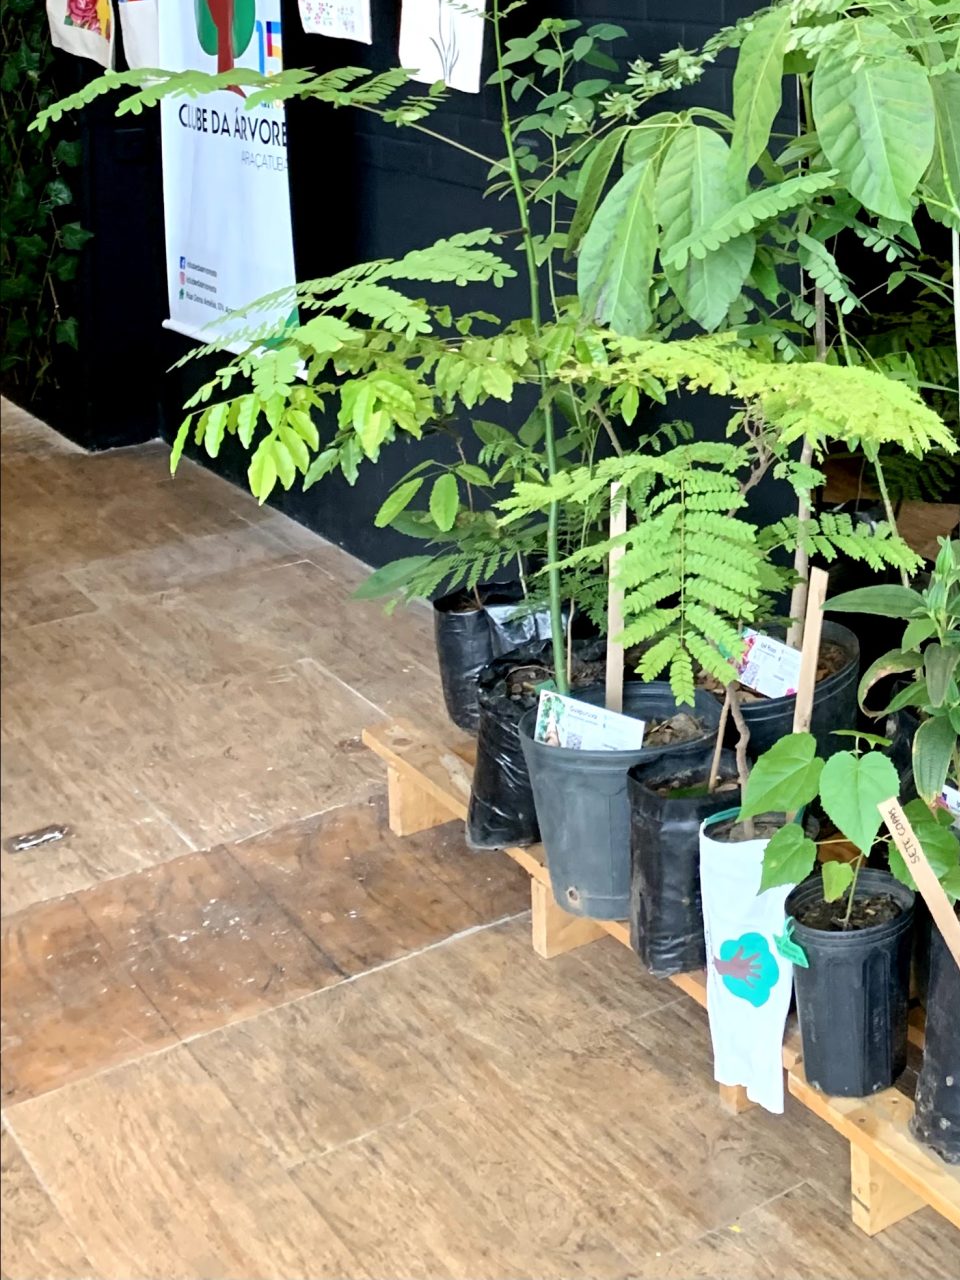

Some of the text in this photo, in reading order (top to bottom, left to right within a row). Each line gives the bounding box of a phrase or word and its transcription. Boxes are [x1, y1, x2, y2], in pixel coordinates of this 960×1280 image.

[178, 103, 287, 147] CLUBE DA ÁRVORE
